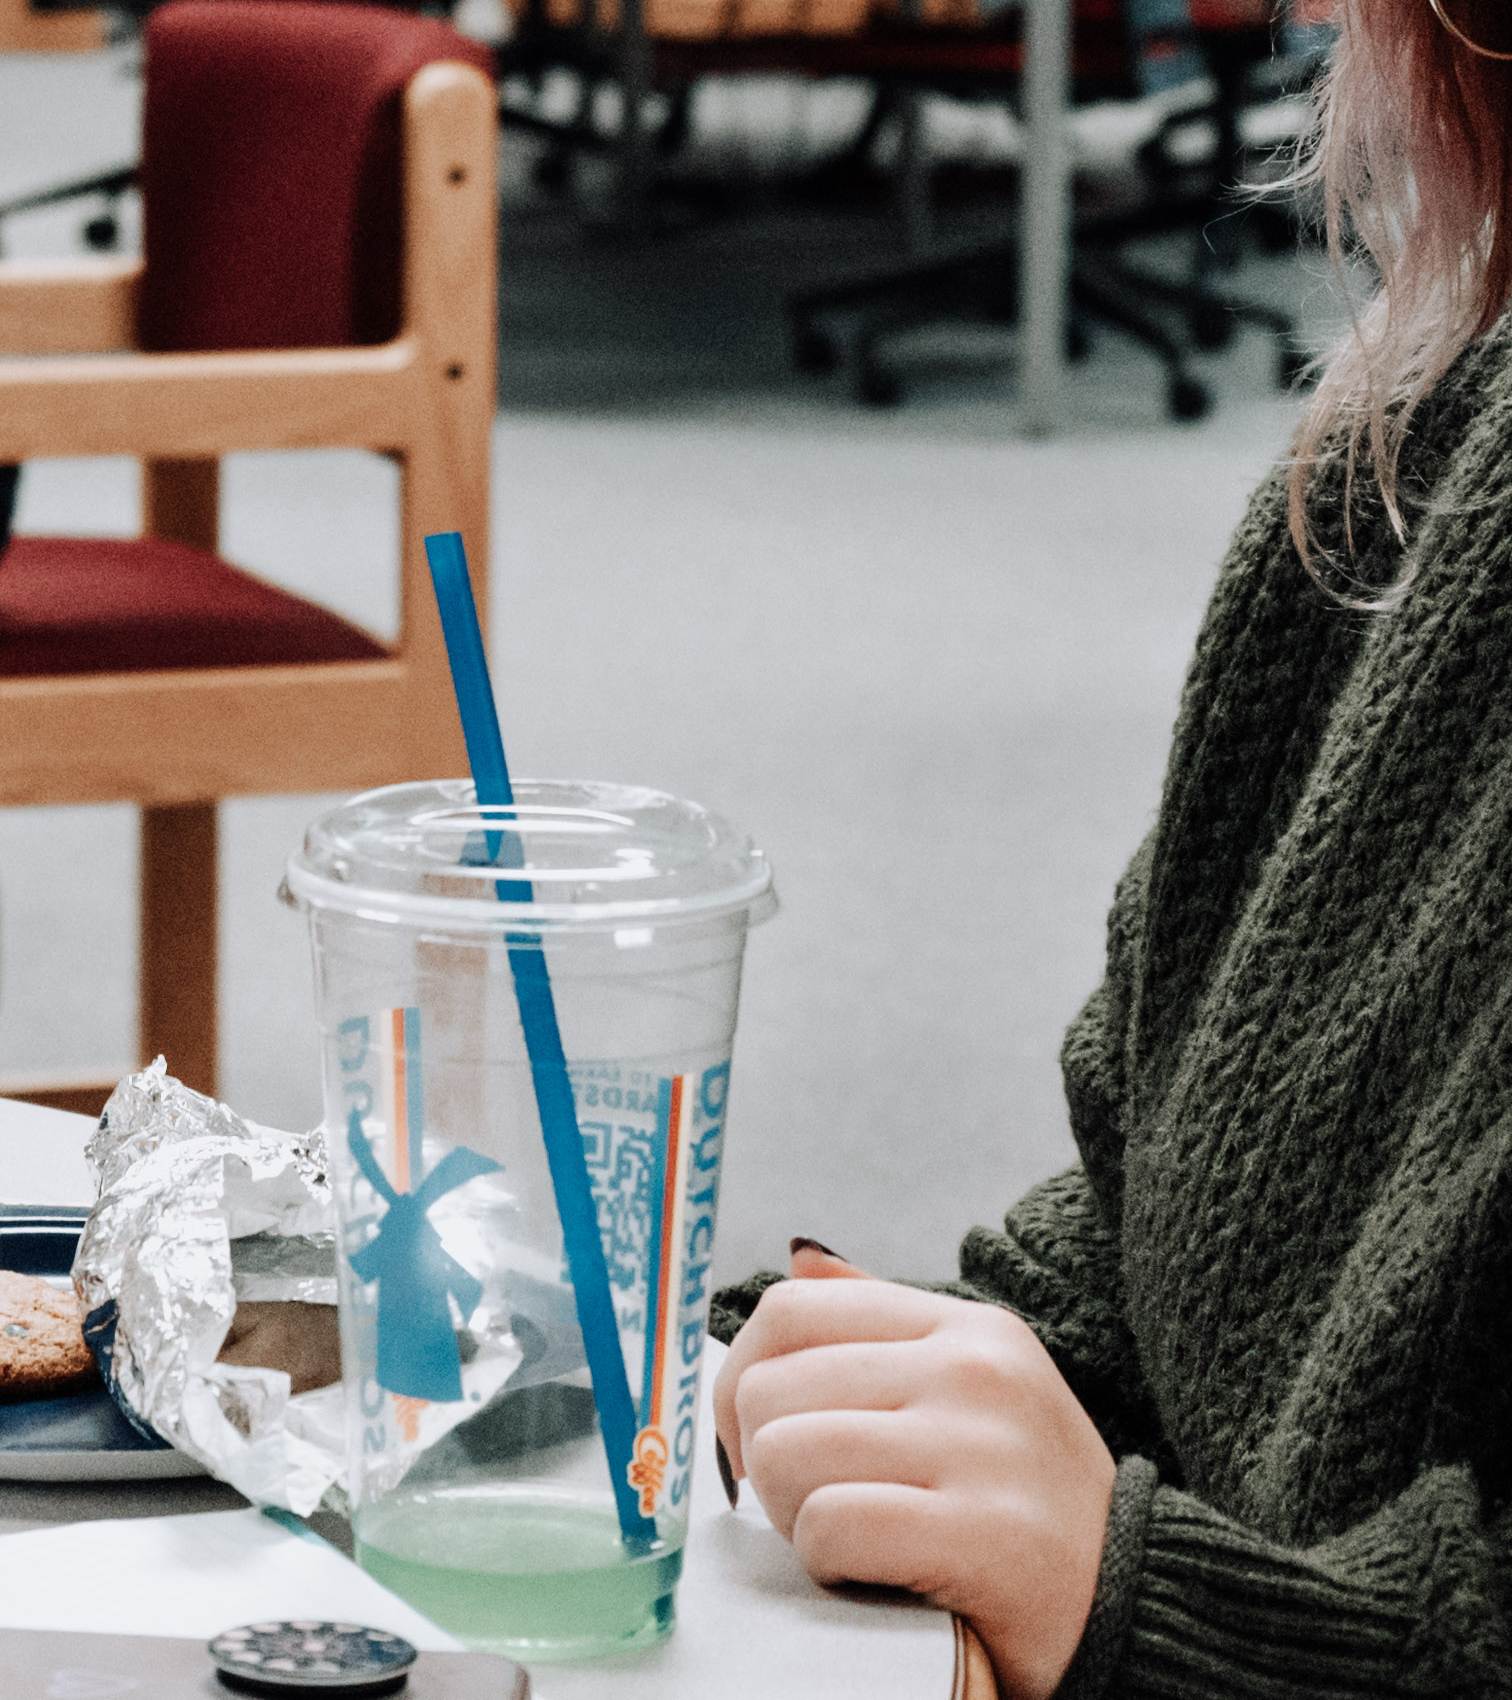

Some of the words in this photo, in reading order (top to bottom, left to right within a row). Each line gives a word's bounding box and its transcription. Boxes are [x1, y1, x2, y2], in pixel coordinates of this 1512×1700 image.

[678, 1060, 730, 1308] DUTCH
[629, 1429, 668, 1514] Coffee
[670, 1321, 706, 1507] BROS
